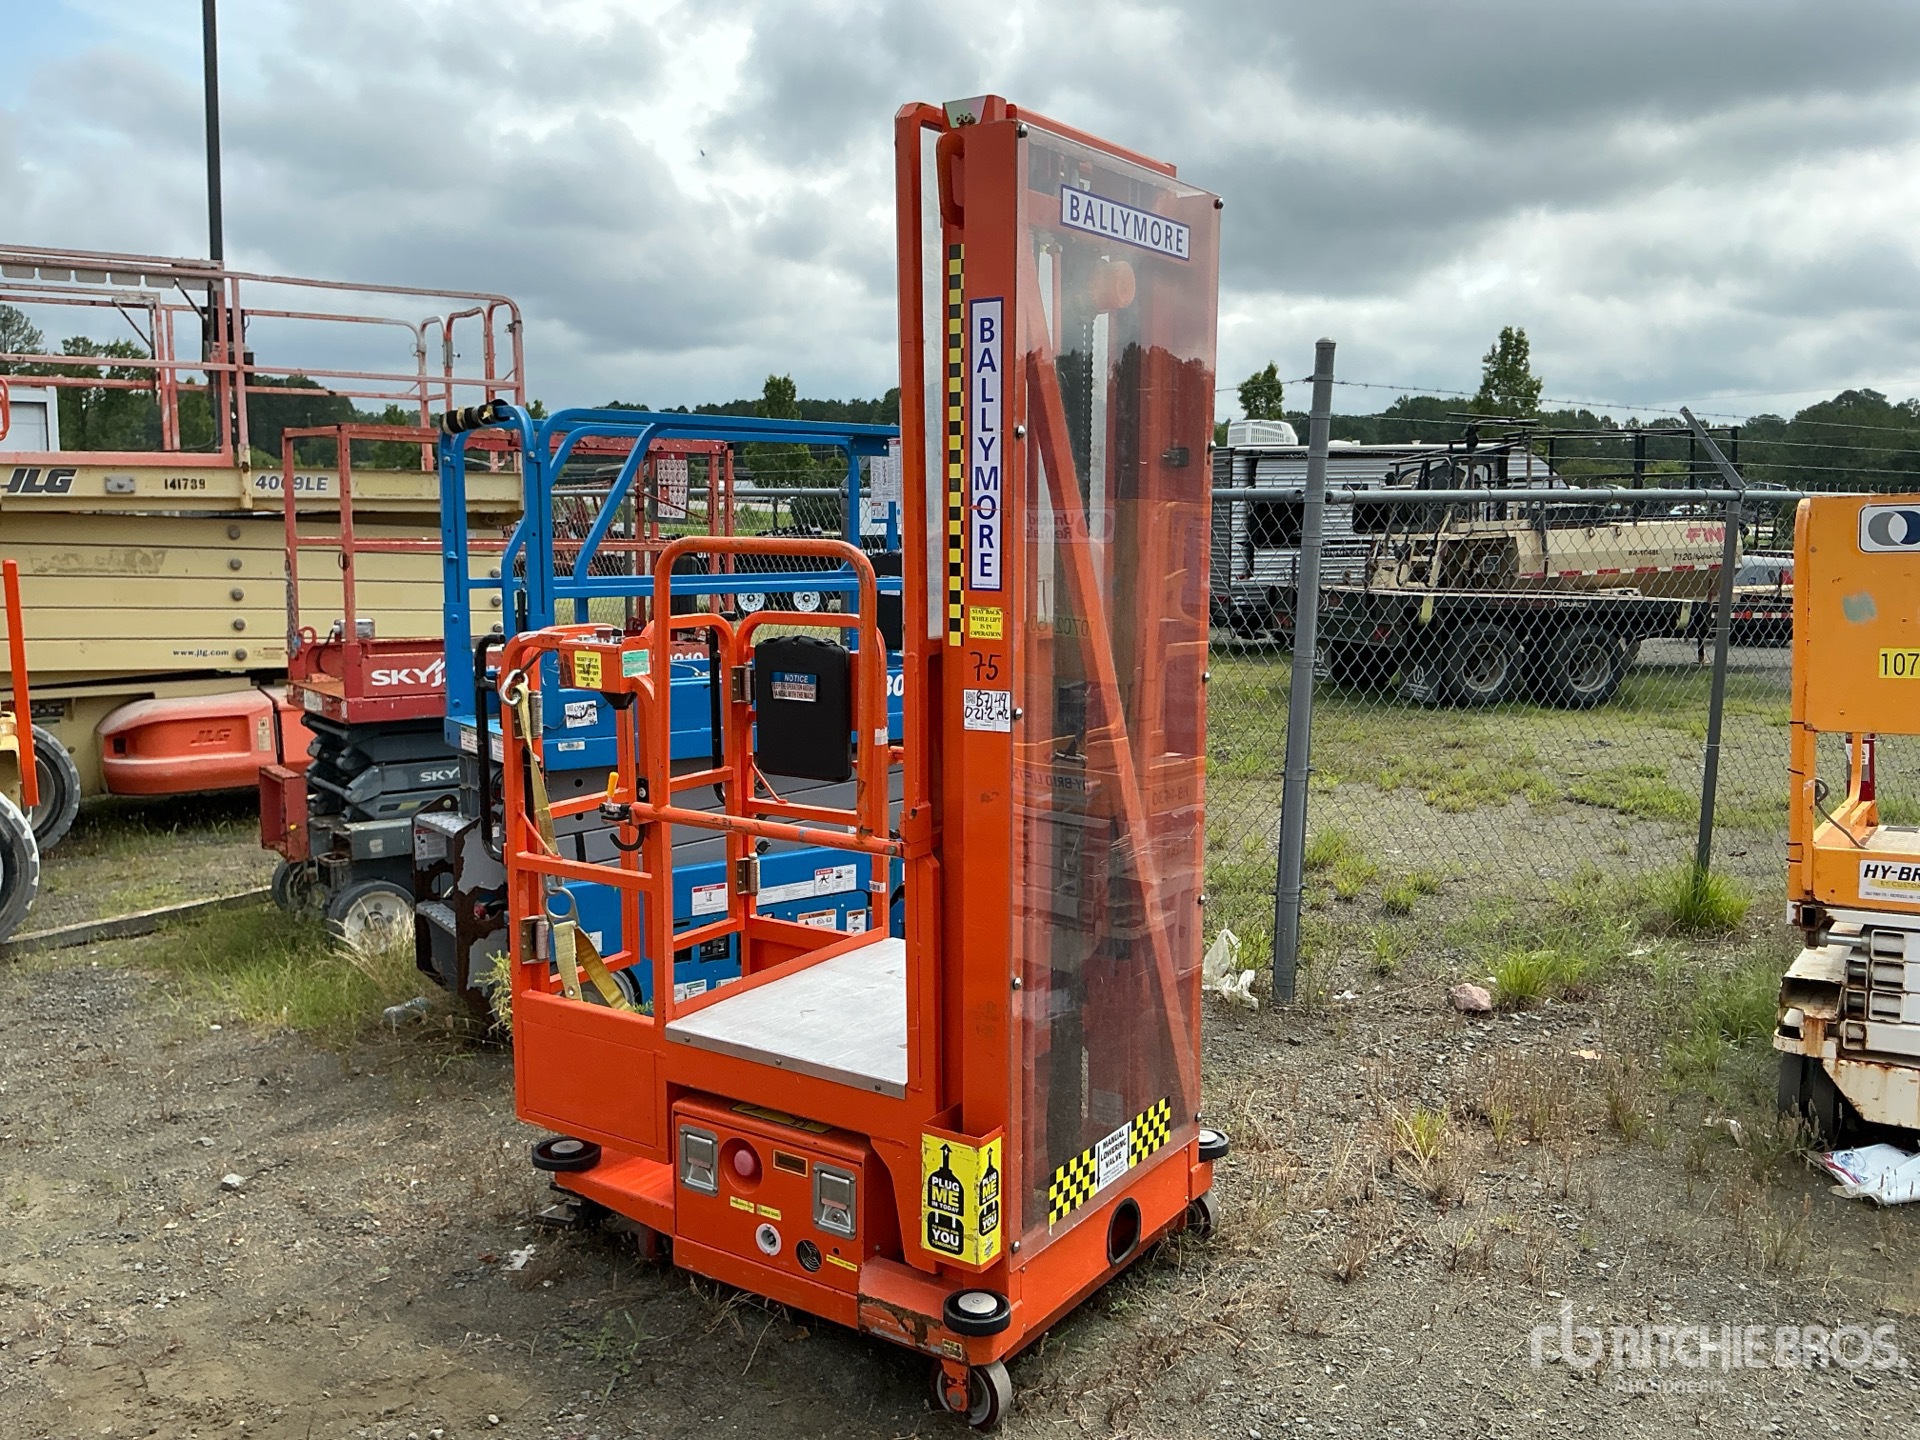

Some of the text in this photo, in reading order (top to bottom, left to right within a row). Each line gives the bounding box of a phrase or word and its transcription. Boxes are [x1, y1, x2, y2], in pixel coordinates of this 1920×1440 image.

[1069, 194, 1184, 253] BALLYMORE
[975, 317, 998, 577] BALLYMORE
[1, 468, 77, 493] JLG
[164, 478, 206, 490] 141739
[1686, 527, 1725, 543] FIN
[172, 649, 229, 657] www.jlg.com
[371, 657, 446, 688] SKYJ
[969, 651, 1002, 682] 75
[784, 673, 809, 683] NOTICE
[190, 729, 231, 746] JLG
[1102, 1129, 1125, 1150] MANUAL
[1100, 1137, 1127, 1162] LOWERING
[1105, 1151, 1122, 1169] VALVE
[931, 1176, 960, 1192] PLUG
[982, 1171, 997, 1187] PLUG
[931, 1185, 960, 1208] ME
[982, 1179, 997, 1199] ME
[939, 1202, 960, 1214] TODAY
[982, 1212, 997, 1230] YOU
[931, 1228, 960, 1247] YOU
